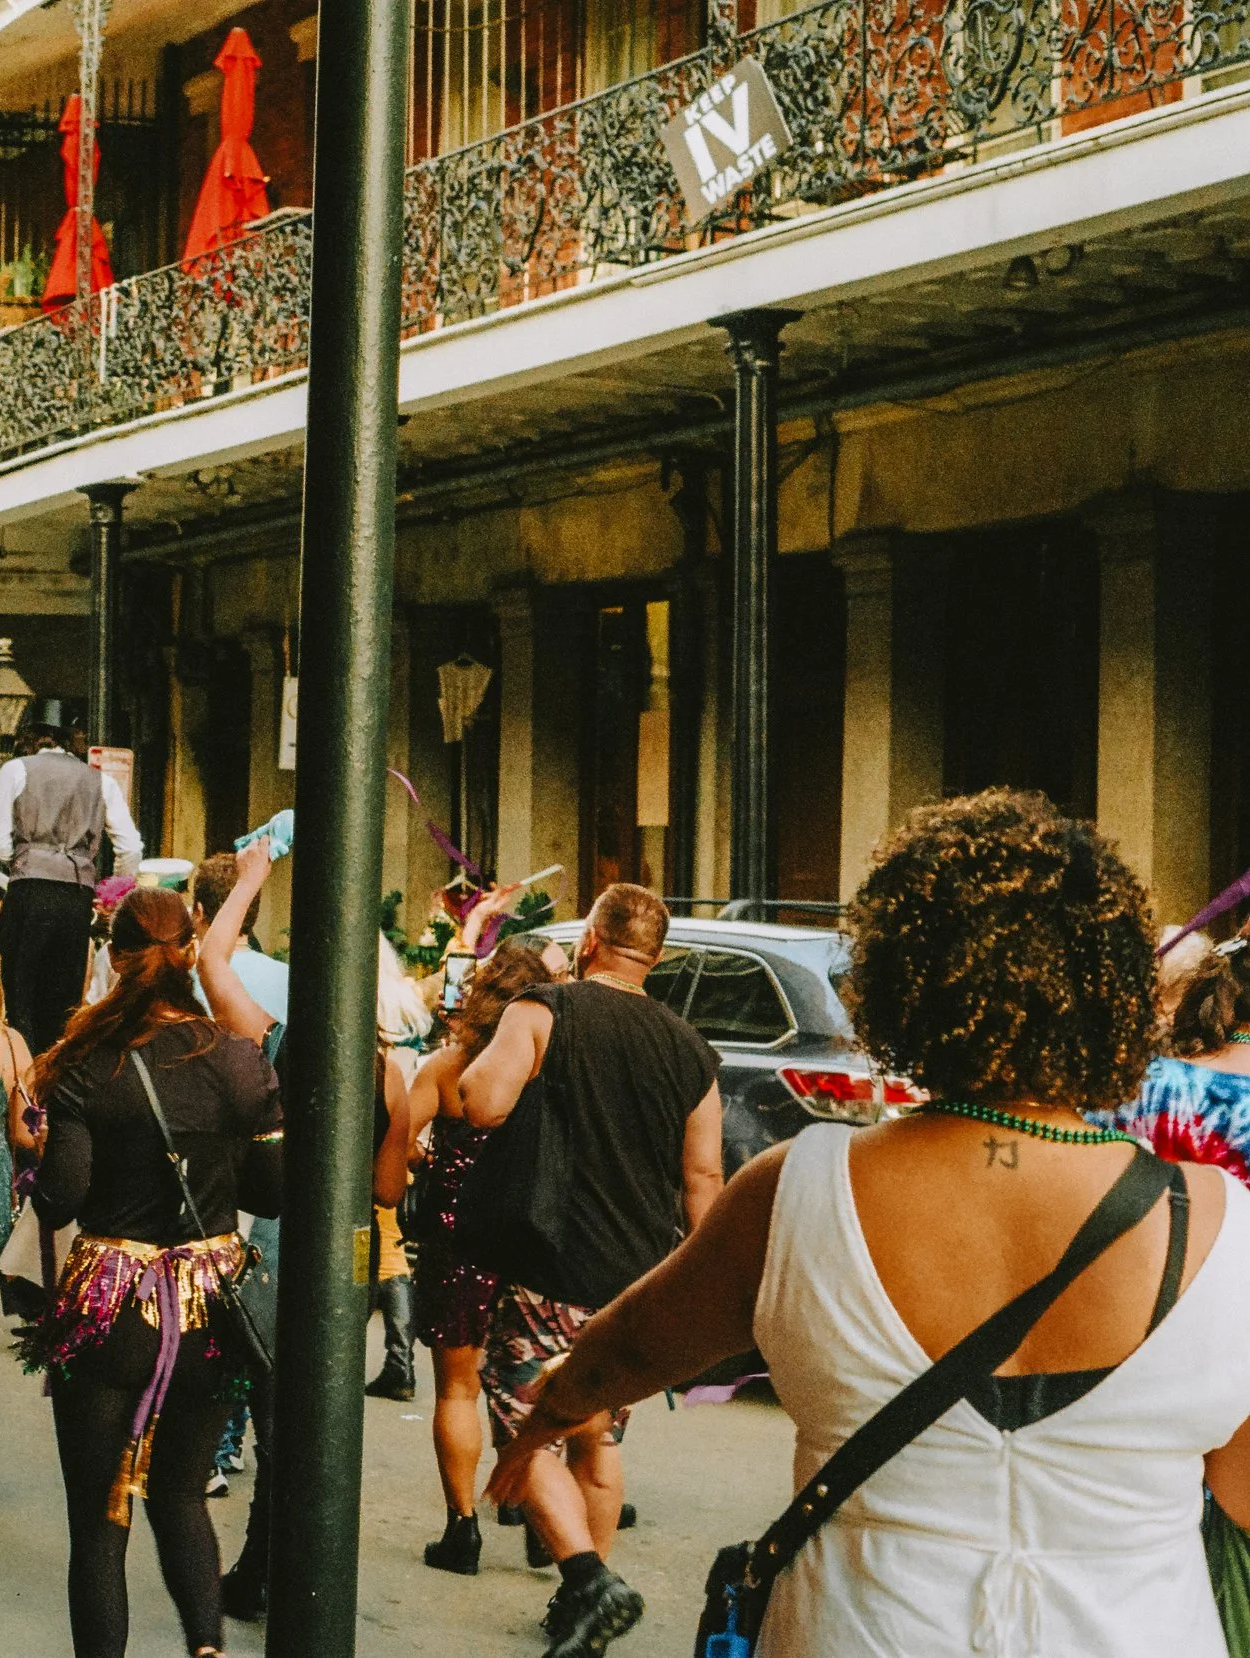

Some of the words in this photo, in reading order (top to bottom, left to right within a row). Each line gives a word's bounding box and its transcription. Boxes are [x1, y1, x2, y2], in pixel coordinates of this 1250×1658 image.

[684, 74, 736, 125] KEEP
[684, 81, 749, 183] IV
[700, 133, 777, 204] WASTE
